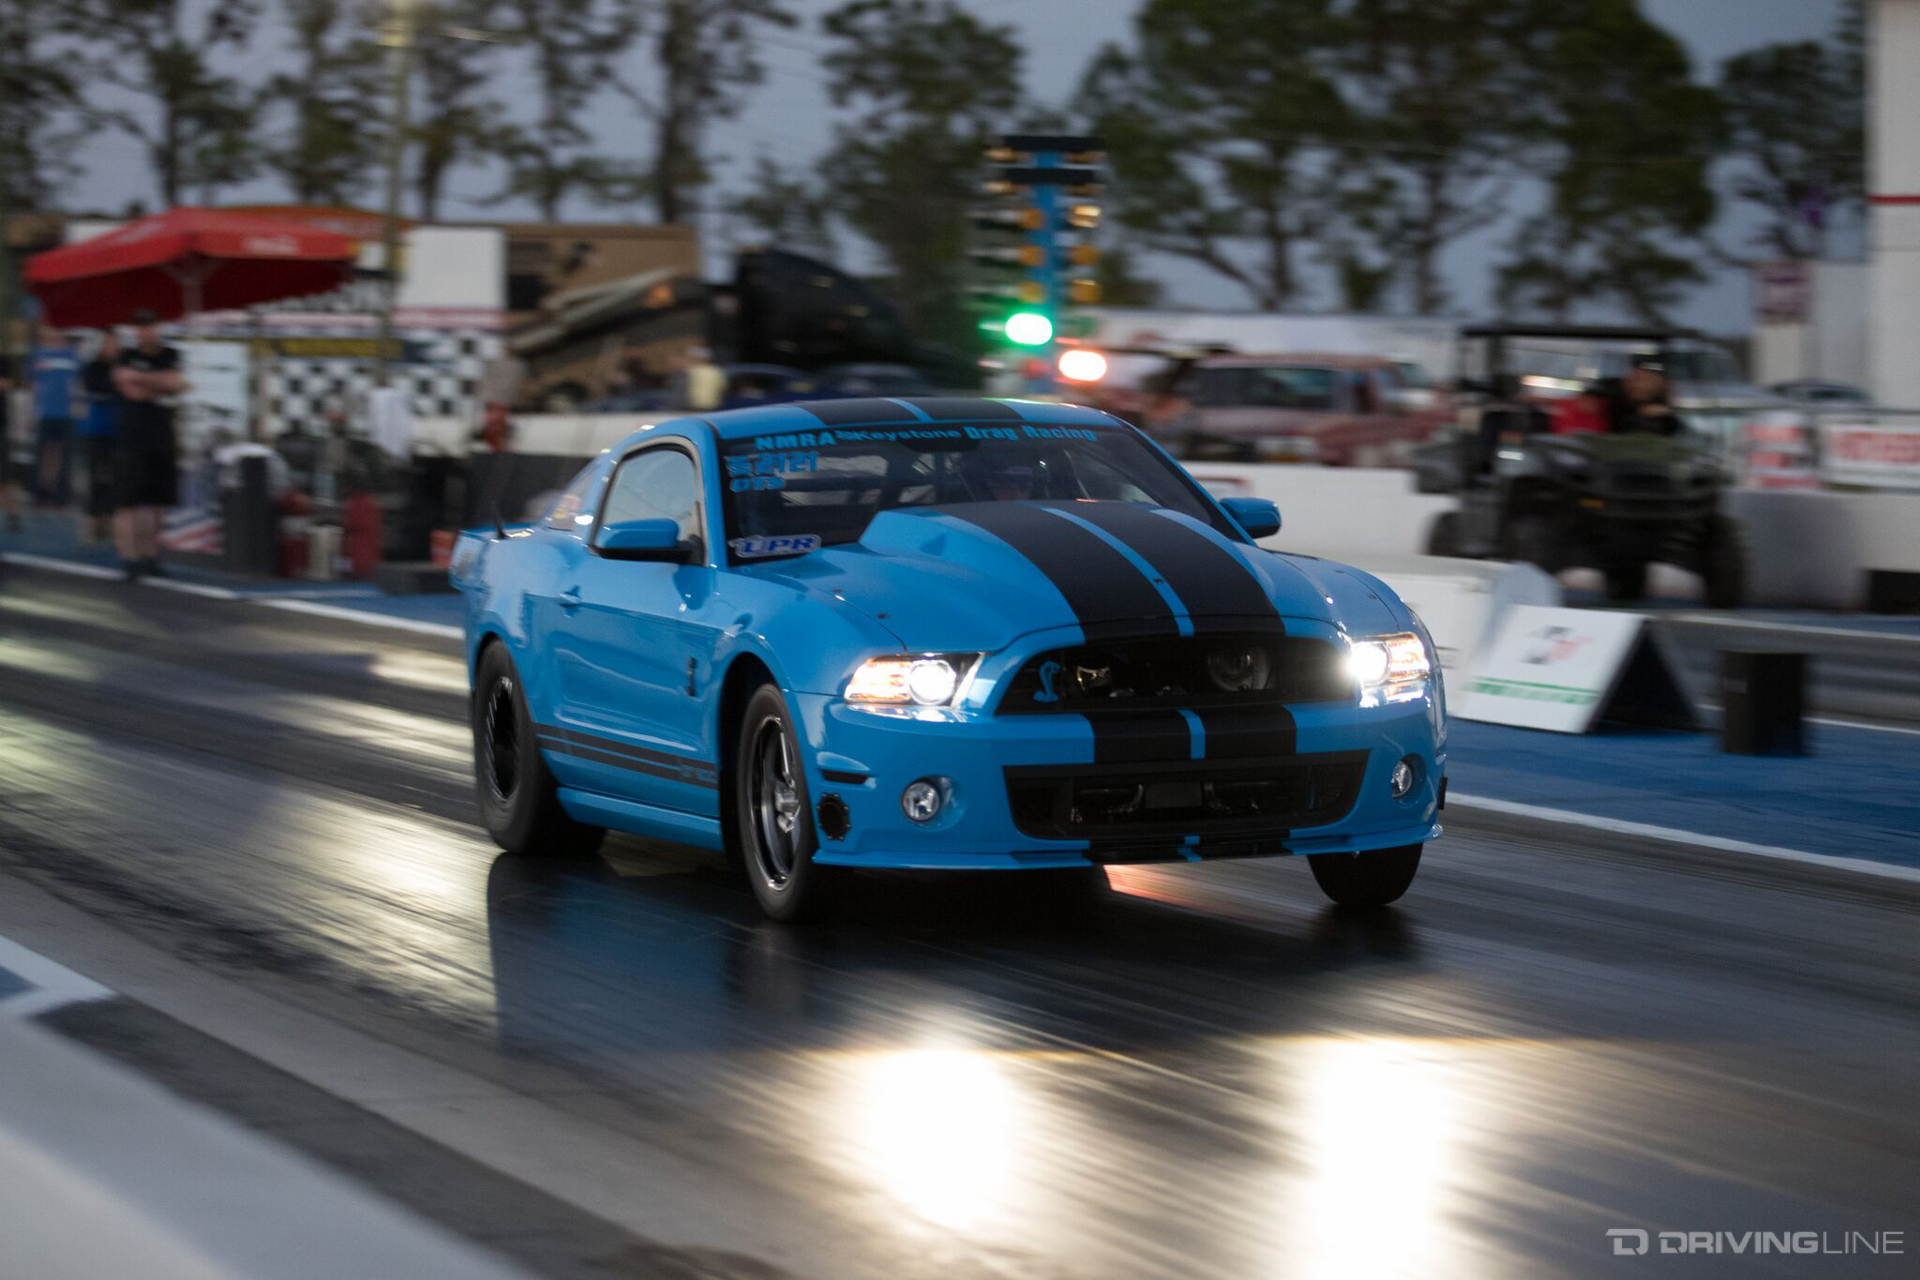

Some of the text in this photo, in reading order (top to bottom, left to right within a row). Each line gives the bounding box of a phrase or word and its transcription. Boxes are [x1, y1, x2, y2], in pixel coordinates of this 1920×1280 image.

[755, 431, 837, 450] NMRA
[854, 429, 961, 441] Keystone
[962, 425, 1019, 441] Drag
[1021, 425, 1097, 442] Racing
